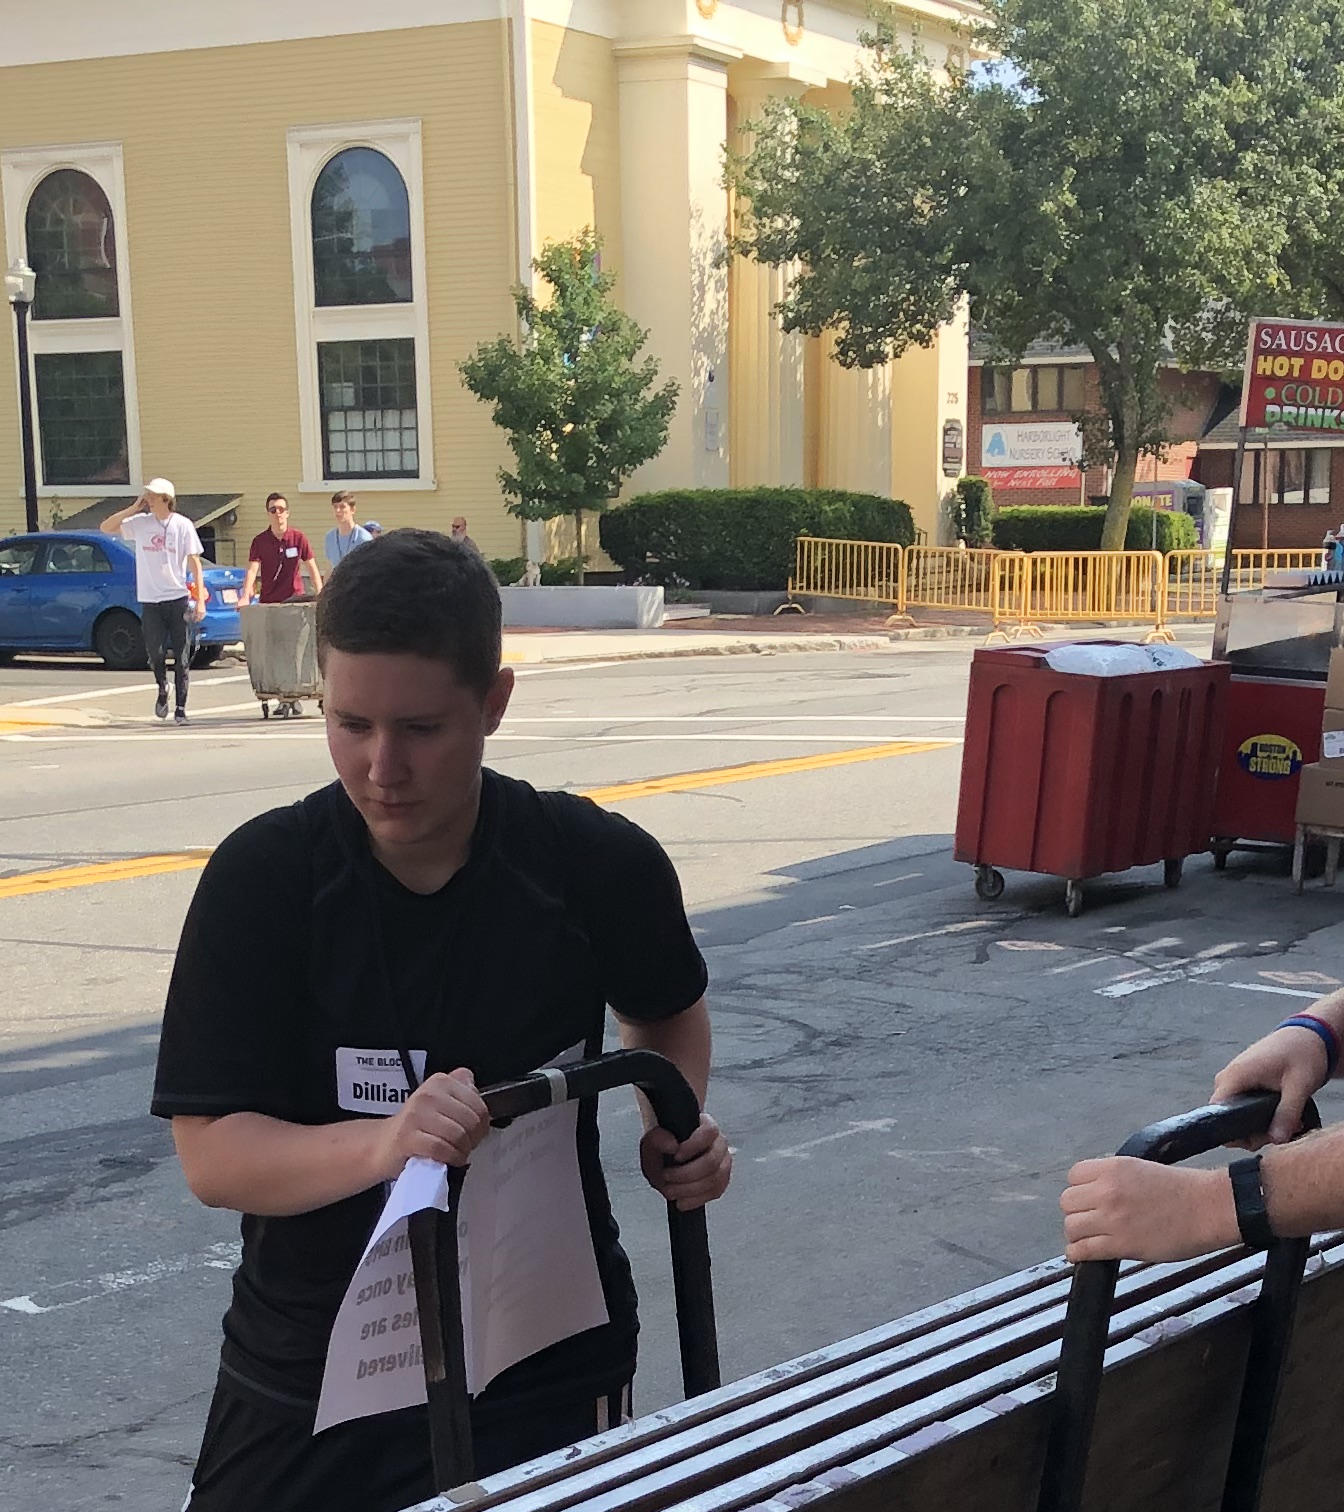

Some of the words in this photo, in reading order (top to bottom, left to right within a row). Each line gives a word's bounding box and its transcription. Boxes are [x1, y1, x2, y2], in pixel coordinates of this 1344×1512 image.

[1256, 355, 1305, 378] HOT
[1281, 383, 1343, 407] COLD
[1009, 448, 1045, 460] NURSERY
[984, 470, 1012, 479] NOW
[1013, 468, 1077, 479] ENROLLING
[1249, 756, 1291, 775] STRONG
[356, 1056, 374, 1066] THE
[377, 1057, 403, 1067] BLOC
